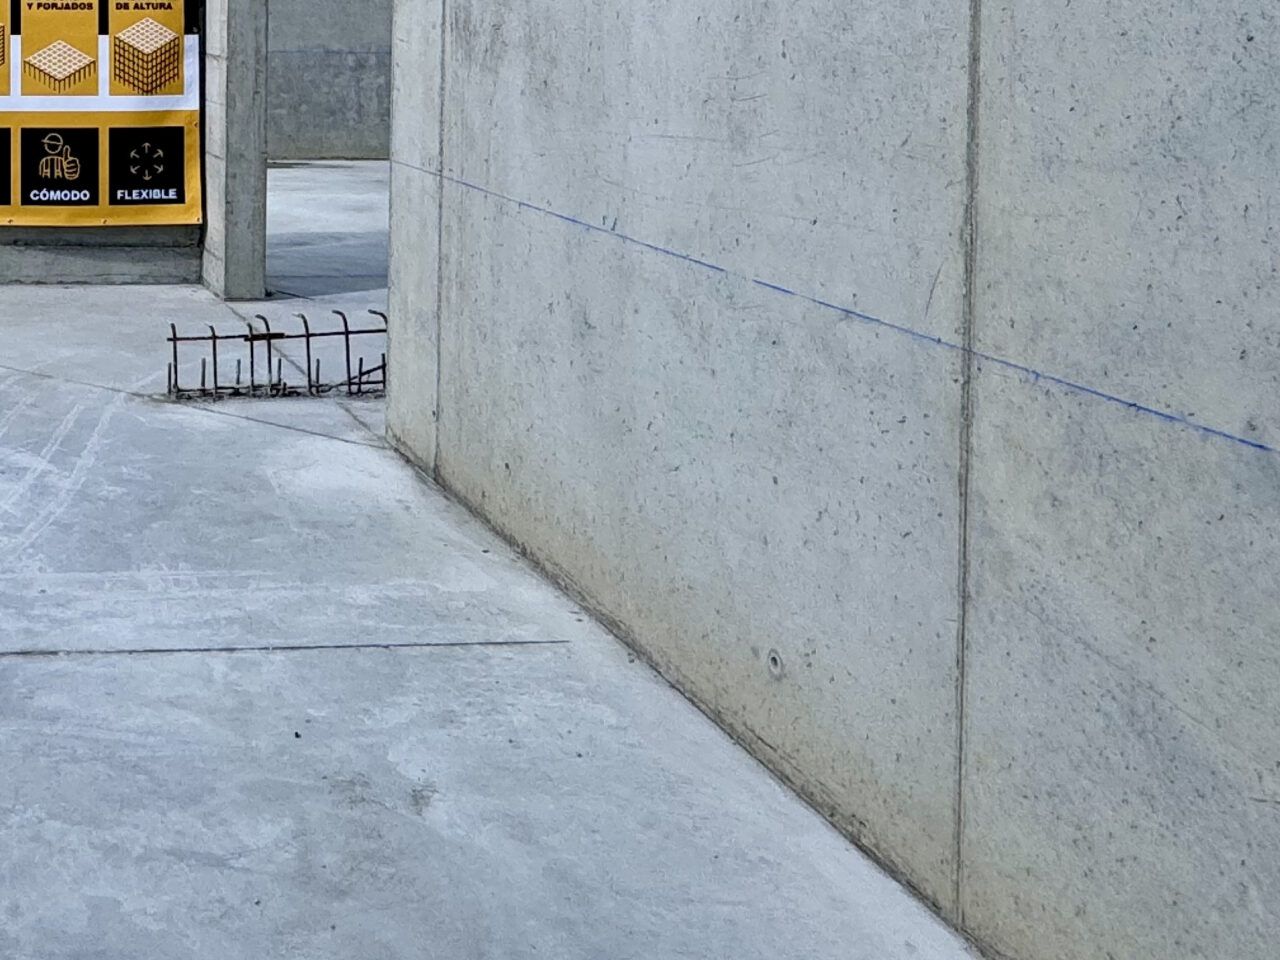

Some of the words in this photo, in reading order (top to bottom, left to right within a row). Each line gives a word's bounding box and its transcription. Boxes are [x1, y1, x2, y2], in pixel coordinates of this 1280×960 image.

[26, 2, 33, 10] Y
[37, 2, 93, 10] FORJADOS
[115, 2, 130, 10] DE
[133, 2, 173, 10] ALTURA
[30, 188, 90, 201] CÓMODO
[117, 188, 177, 200] FLEXIBLE
